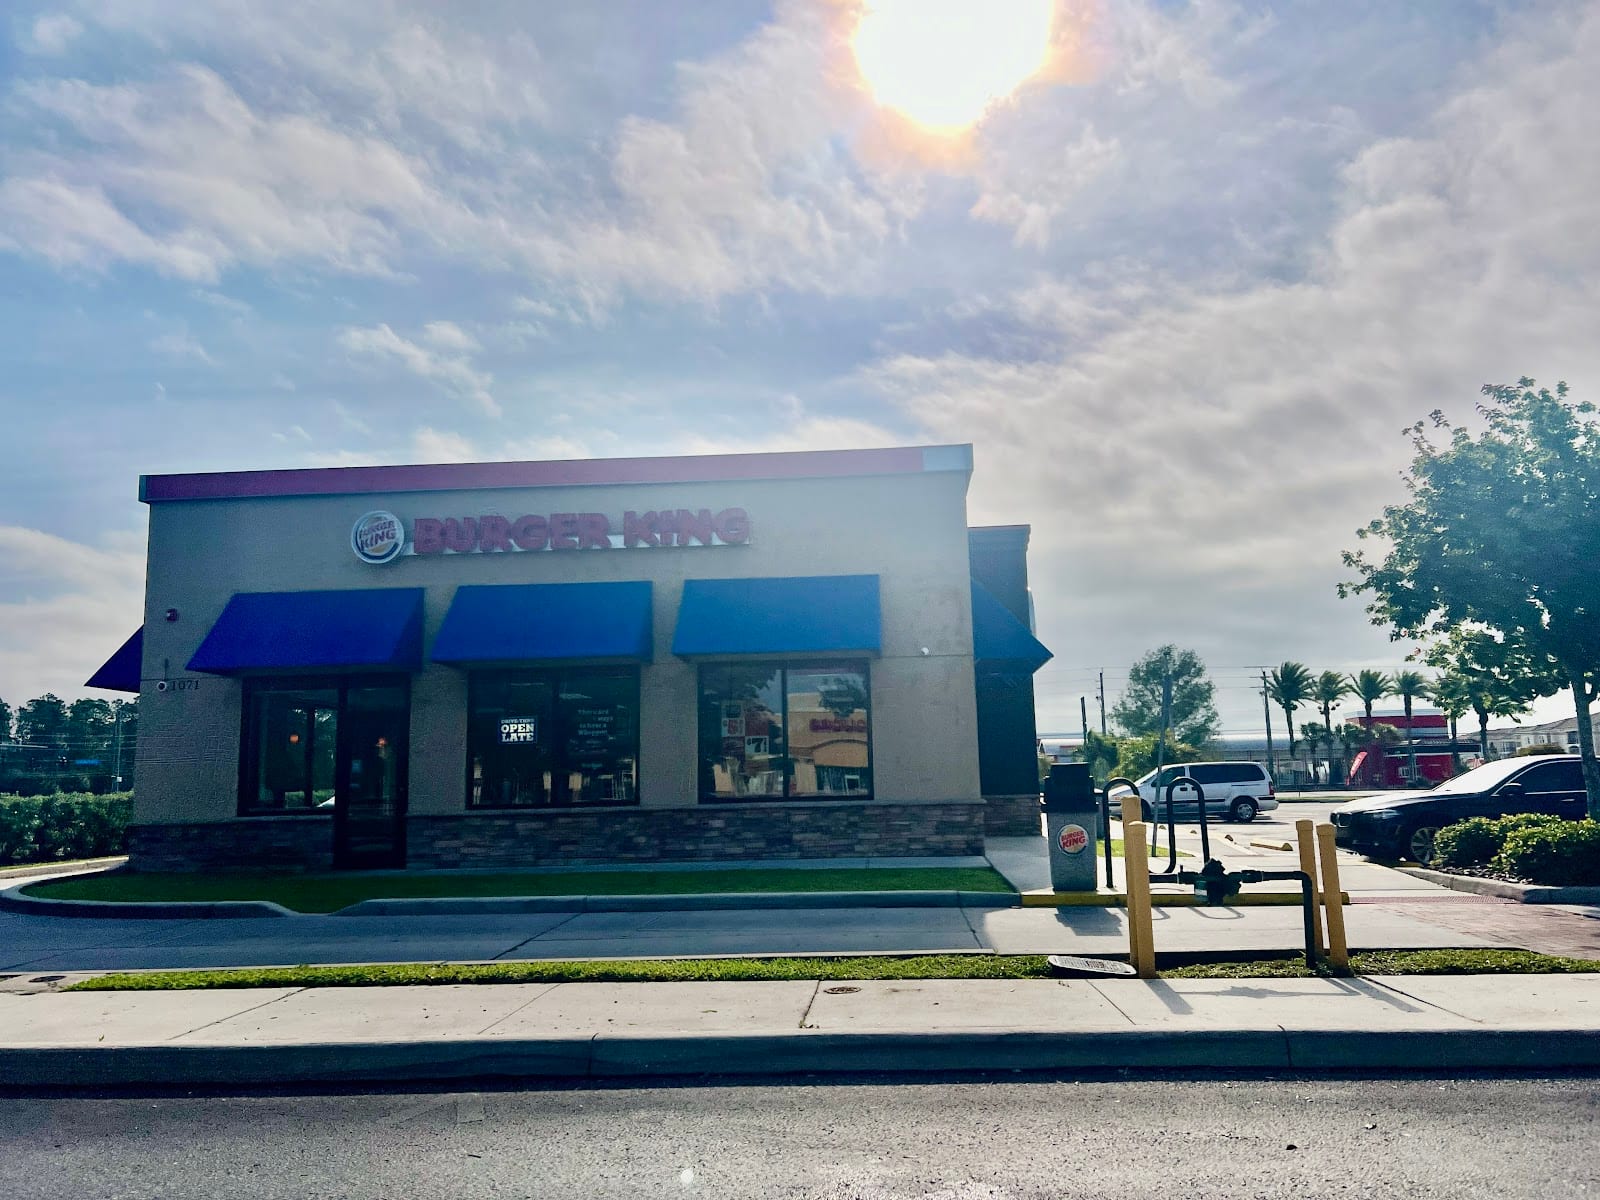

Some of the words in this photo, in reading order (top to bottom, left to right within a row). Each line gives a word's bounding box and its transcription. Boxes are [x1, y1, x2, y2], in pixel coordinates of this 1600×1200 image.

[414, 513, 612, 553] BURGER
[623, 507, 750, 548] KING
[360, 529, 396, 551] KING
[172, 680, 200, 691] 1071
[501, 723, 534, 733] OPEN
[501, 732, 534, 742] LATE
[1061, 830, 1085, 841] BURGER
[1062, 836, 1086, 848] KING
